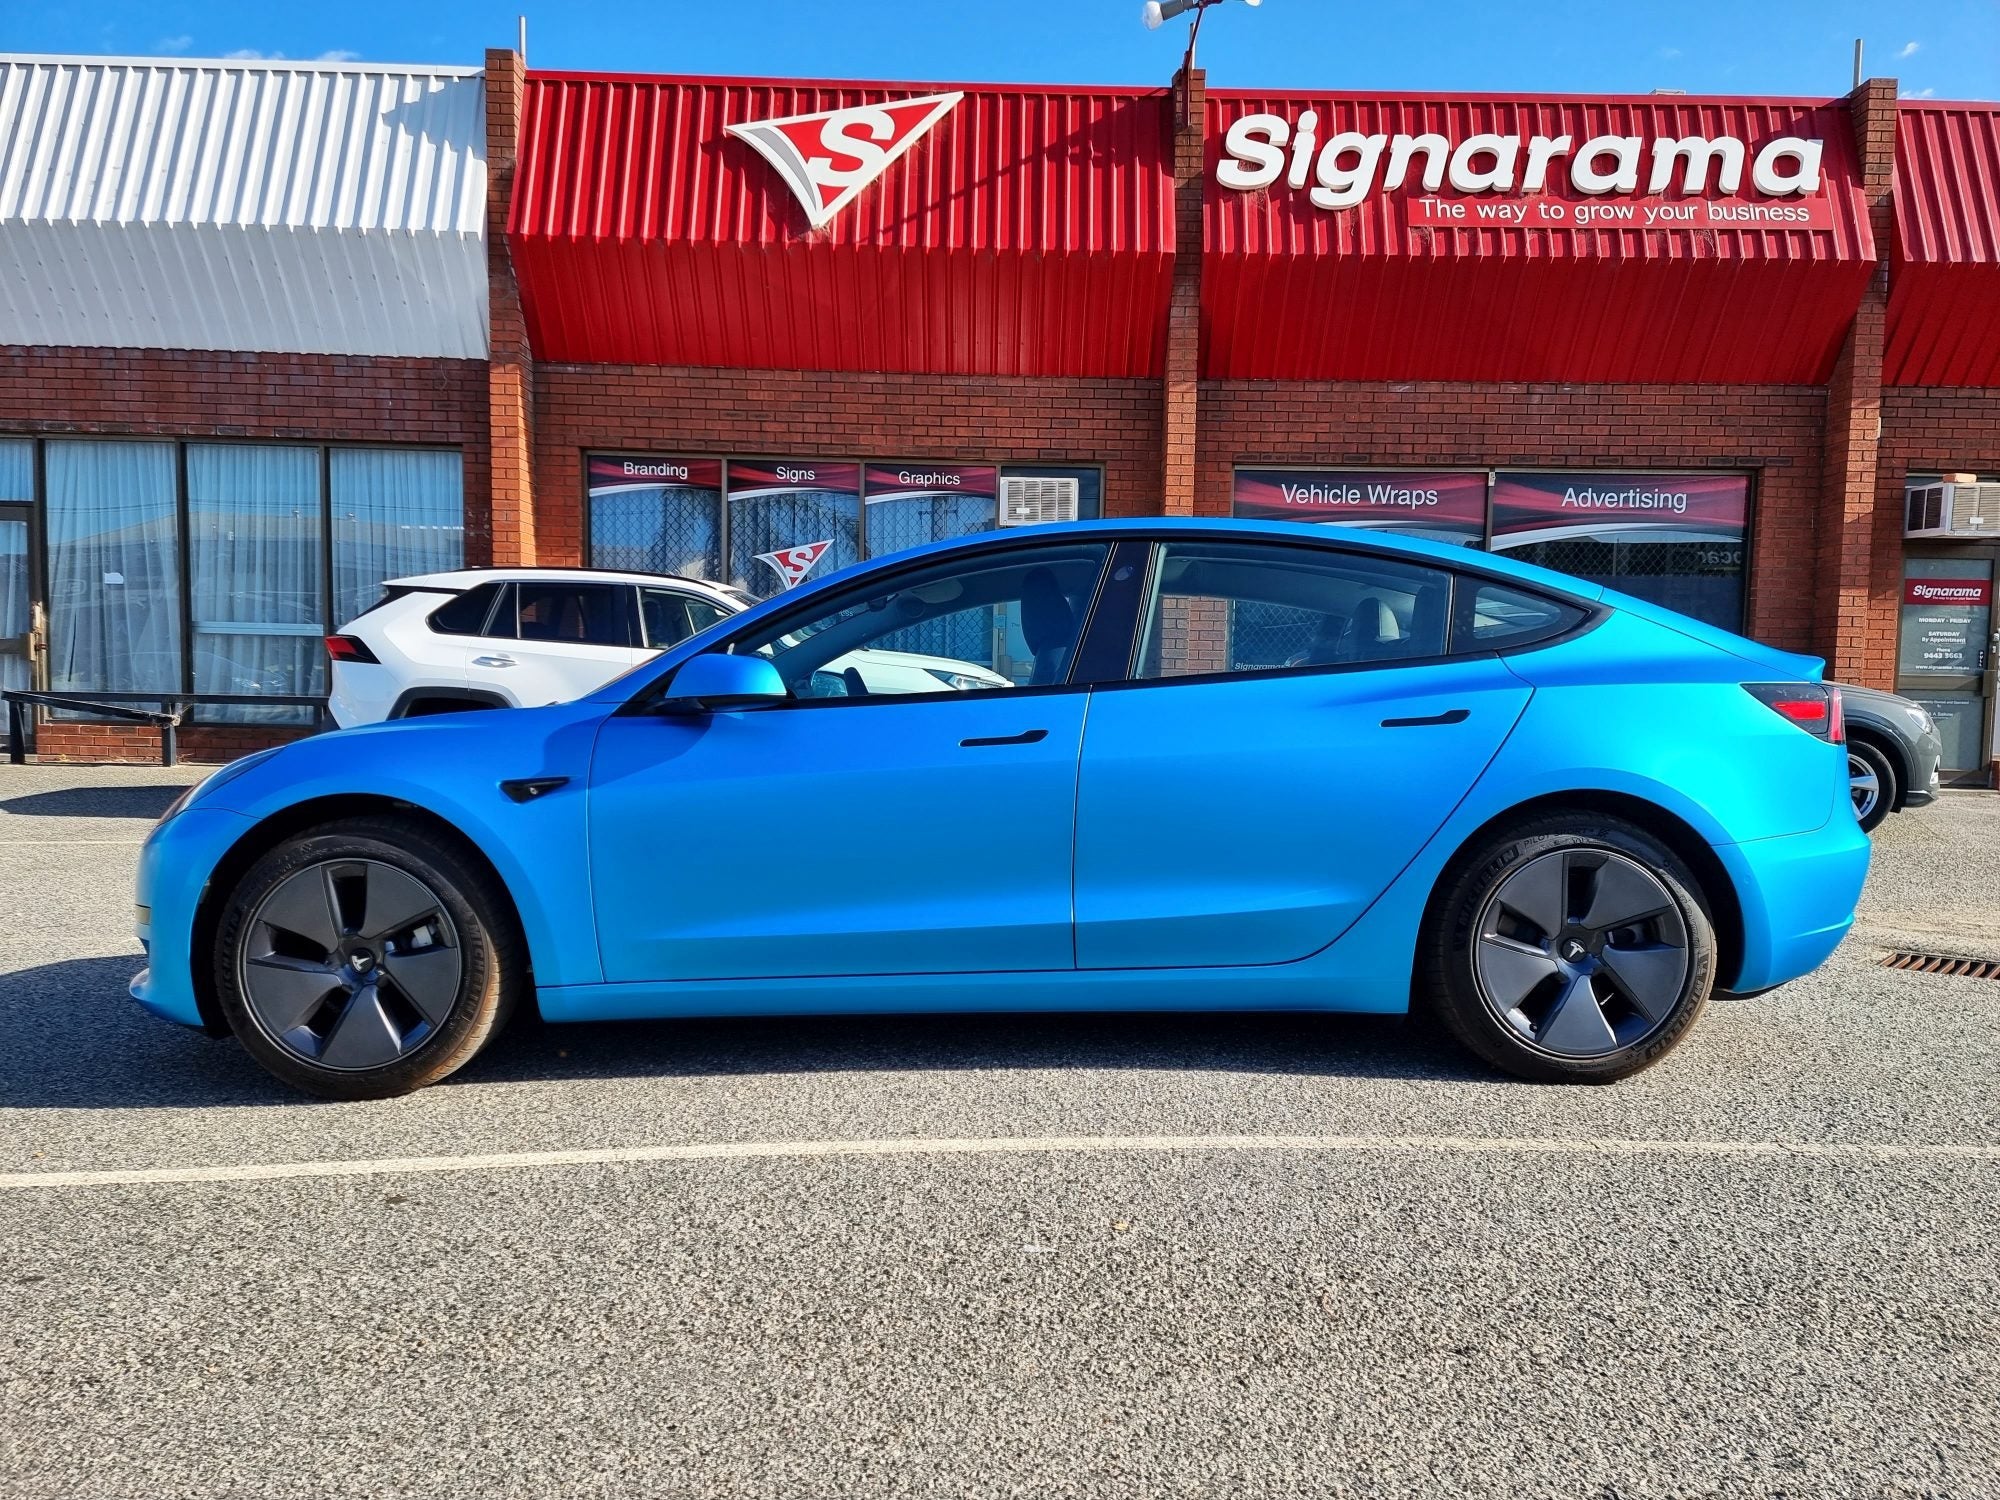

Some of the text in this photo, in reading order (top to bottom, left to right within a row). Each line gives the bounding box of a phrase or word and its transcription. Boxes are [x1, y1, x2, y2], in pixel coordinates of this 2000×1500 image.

[1216, 110, 1824, 210] Signarama
[1419, 199, 1810, 225] The way to grow your business
[623, 462, 688, 481] Branding
[776, 466, 816, 484] Signs
[898, 471, 961, 487] Graphics
[1281, 484, 1439, 509] Vehicle Wraps
[1561, 487, 1688, 513] Advertising
[1913, 585, 1982, 598] Signarama
